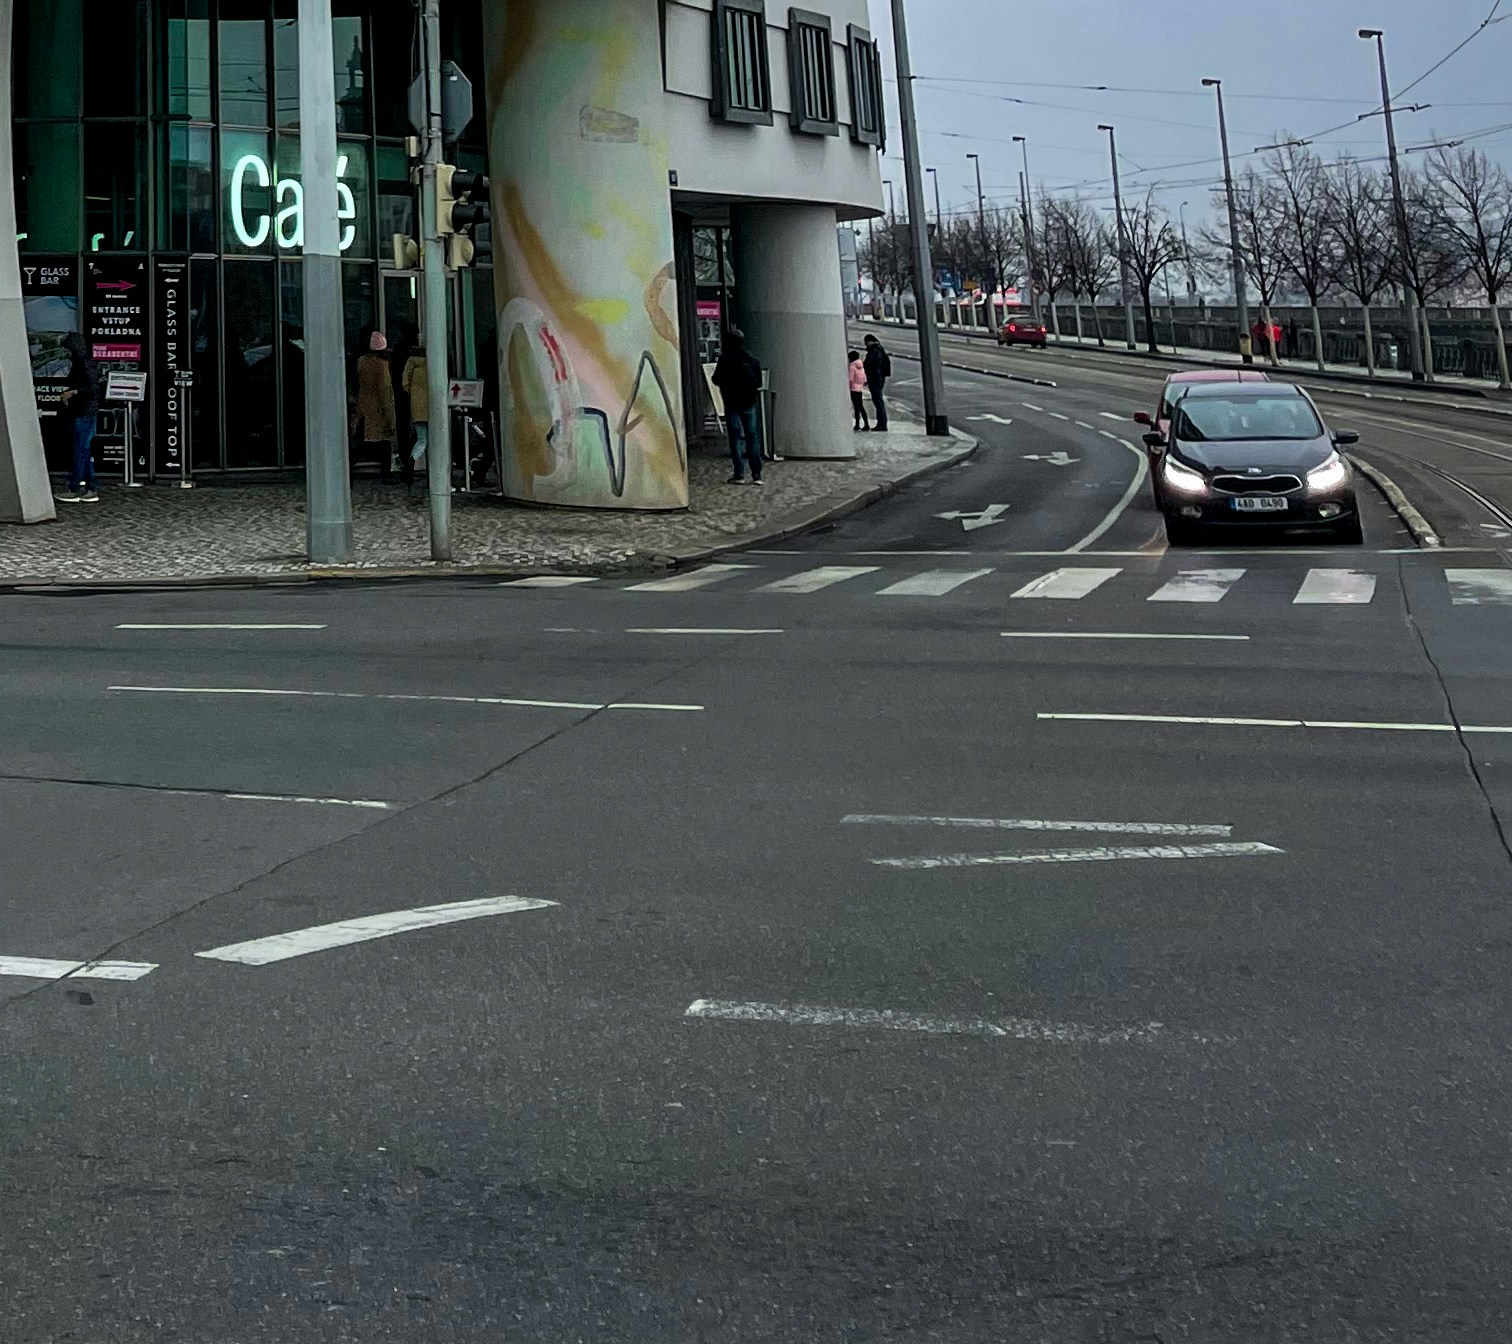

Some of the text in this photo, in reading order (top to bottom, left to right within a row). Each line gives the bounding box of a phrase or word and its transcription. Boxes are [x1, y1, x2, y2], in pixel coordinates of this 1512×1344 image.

[230, 154, 356, 251] Caé
[40, 267, 70, 276] GLASS
[40, 276, 60, 285] BAR
[92, 306, 141, 314] ENTRANCE
[166, 288, 177, 336] GLASS
[167, 387, 178, 421] OOF
[167, 426, 178, 457] TOP
